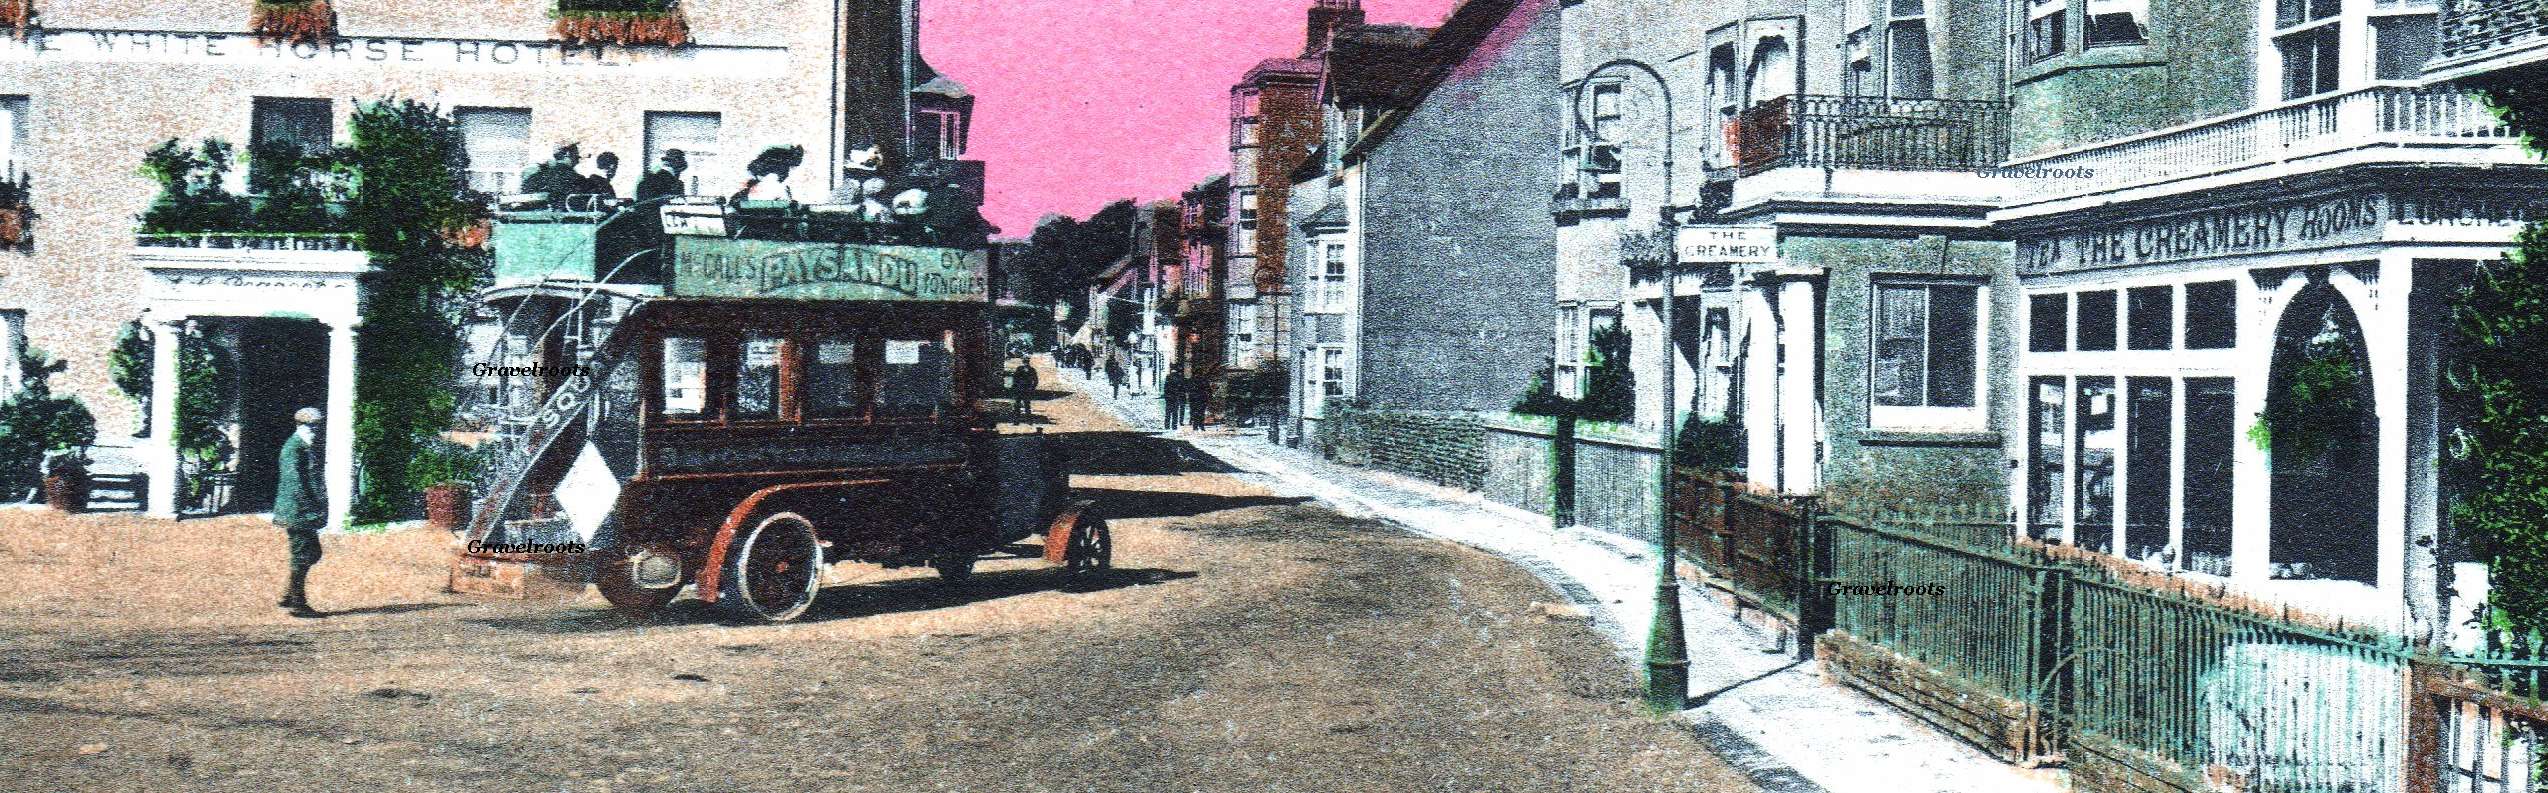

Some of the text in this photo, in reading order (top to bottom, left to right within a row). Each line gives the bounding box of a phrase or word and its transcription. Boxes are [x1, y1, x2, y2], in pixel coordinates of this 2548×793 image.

[88, 31, 225, 56] WHITE
[258, 37, 424, 62] HORSE
[1709, 231, 1747, 240] THE
[2073, 230, 2126, 265] THE
[2135, 202, 2287, 258] CREAMERY
[2300, 197, 2378, 241] ROOMS
[941, 251, 967, 270] OX
[1685, 244, 1770, 258] CREAMERY
[760, 247, 918, 299] PAYSANDU
[924, 271, 986, 296] TONGUES
